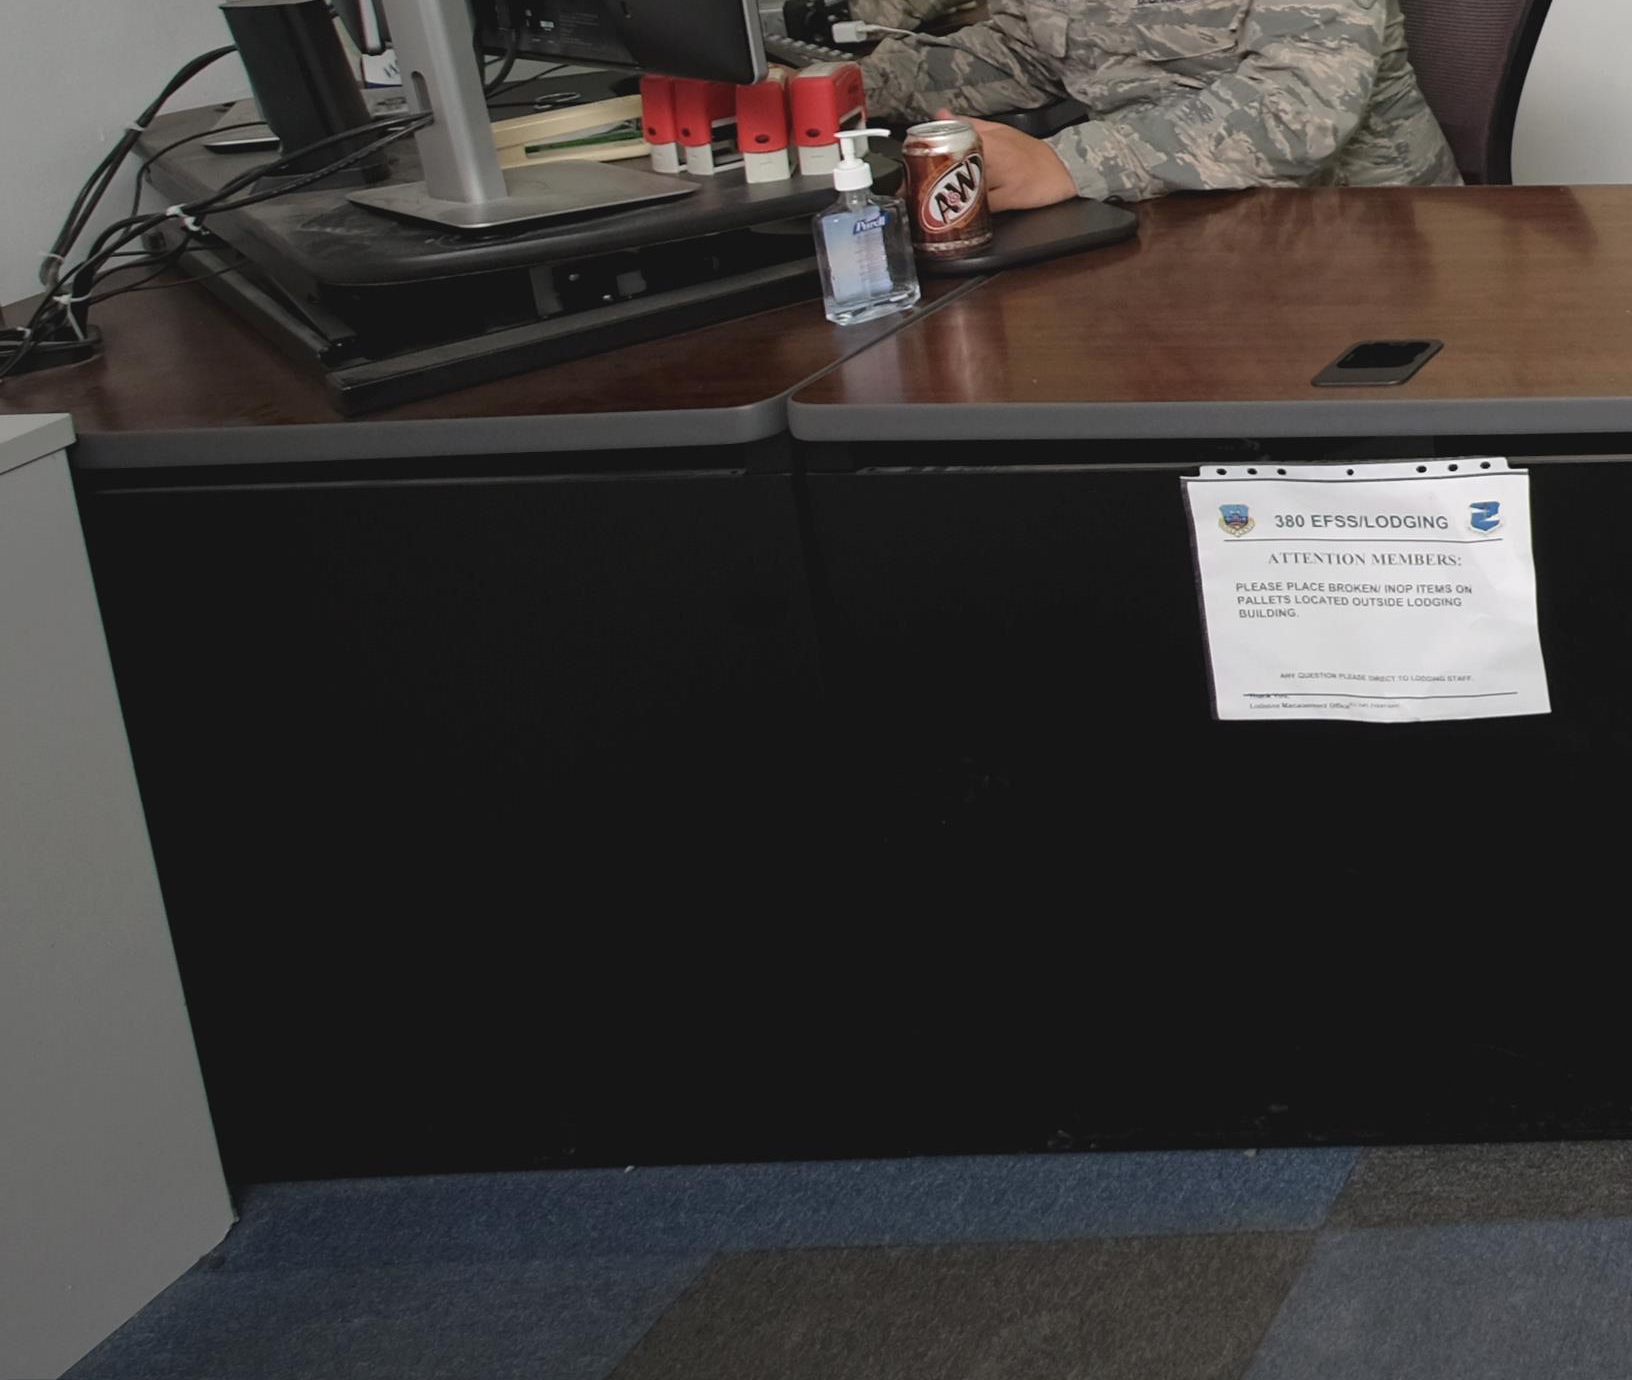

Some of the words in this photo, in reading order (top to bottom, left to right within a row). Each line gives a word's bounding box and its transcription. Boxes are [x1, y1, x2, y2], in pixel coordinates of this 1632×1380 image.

[1274, 514, 1305, 528] 380
[1311, 514, 1449, 529] EFSS/LODGING
[1268, 552, 1366, 566] ATTENTION
[1372, 553, 1462, 567] MEMBERS:
[1236, 582, 1284, 592] PLEASE
[1287, 582, 1325, 592] PLACE
[1329, 583, 1380, 593] BROKEN/
[1385, 583, 1413, 594] INOP
[1417, 584, 1452, 594] ITEMS
[1455, 584, 1472, 594] ON
[1237, 595, 1292, 605] PALLETS
[1295, 595, 1349, 606] LOCATED
[1352, 596, 1404, 607] OUTSIDE
[1408, 597, 1462, 607] LODGING
[1239, 608, 1299, 619] BUILDING.
